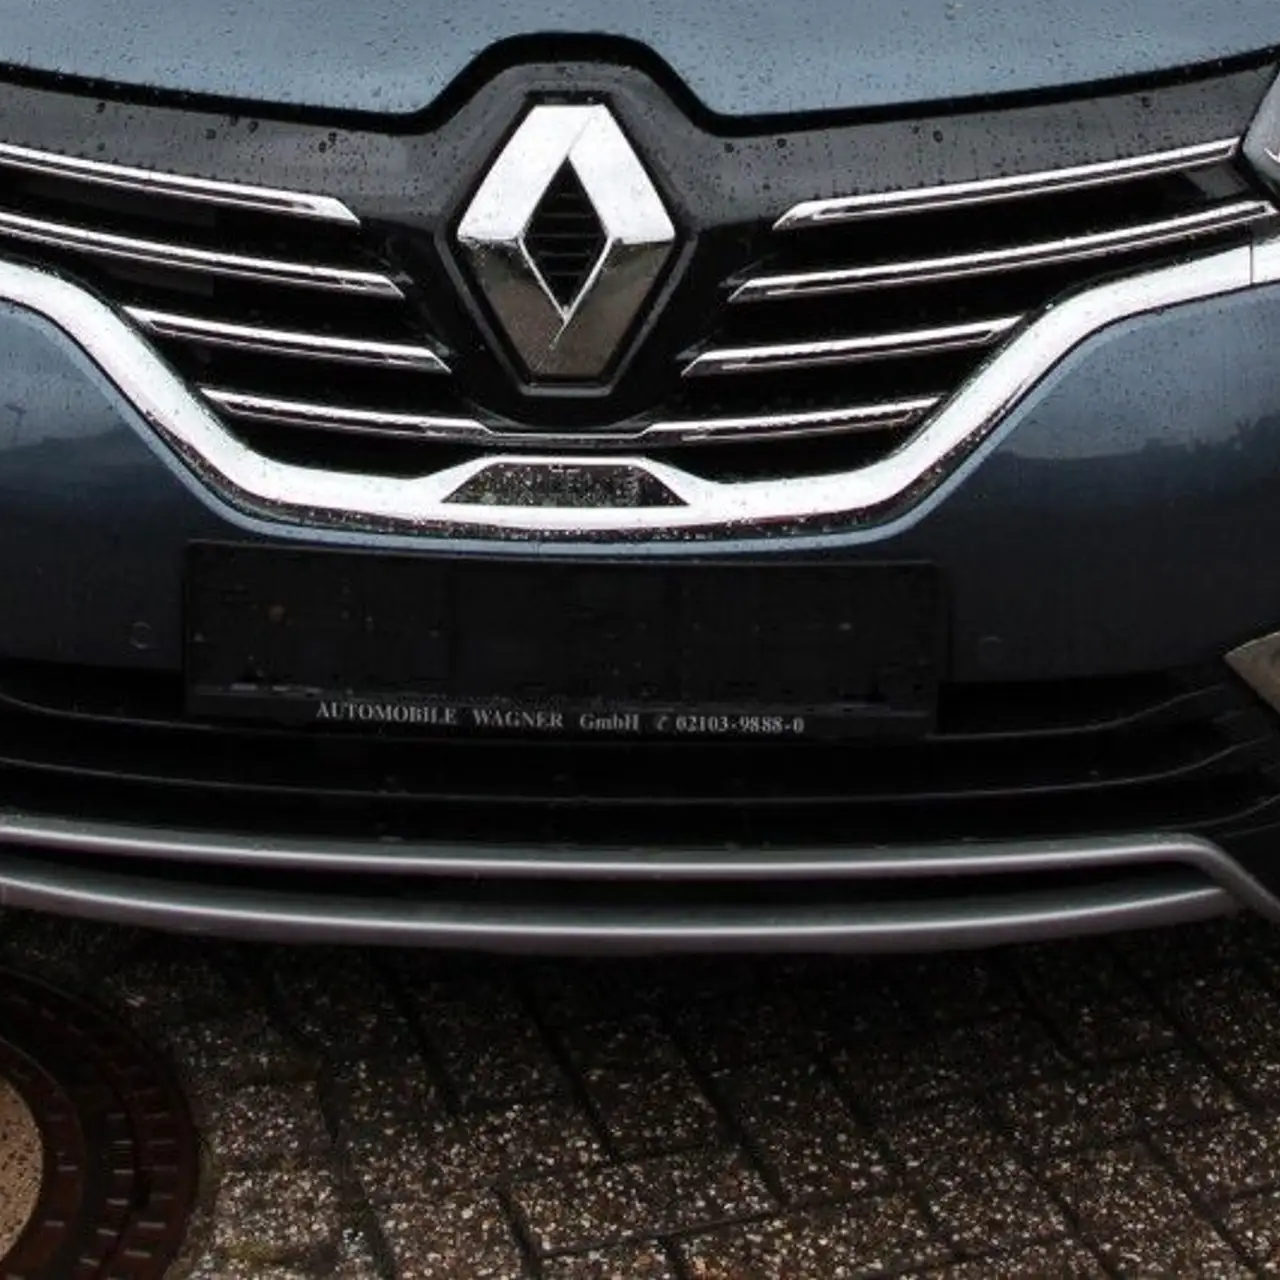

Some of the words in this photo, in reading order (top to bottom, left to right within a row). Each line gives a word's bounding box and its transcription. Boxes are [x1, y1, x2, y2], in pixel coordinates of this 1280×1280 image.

[317, 701, 458, 726] AUTOMOBILE
[472, 708, 564, 729] WAGNER
[579, 712, 639, 732] GmbH
